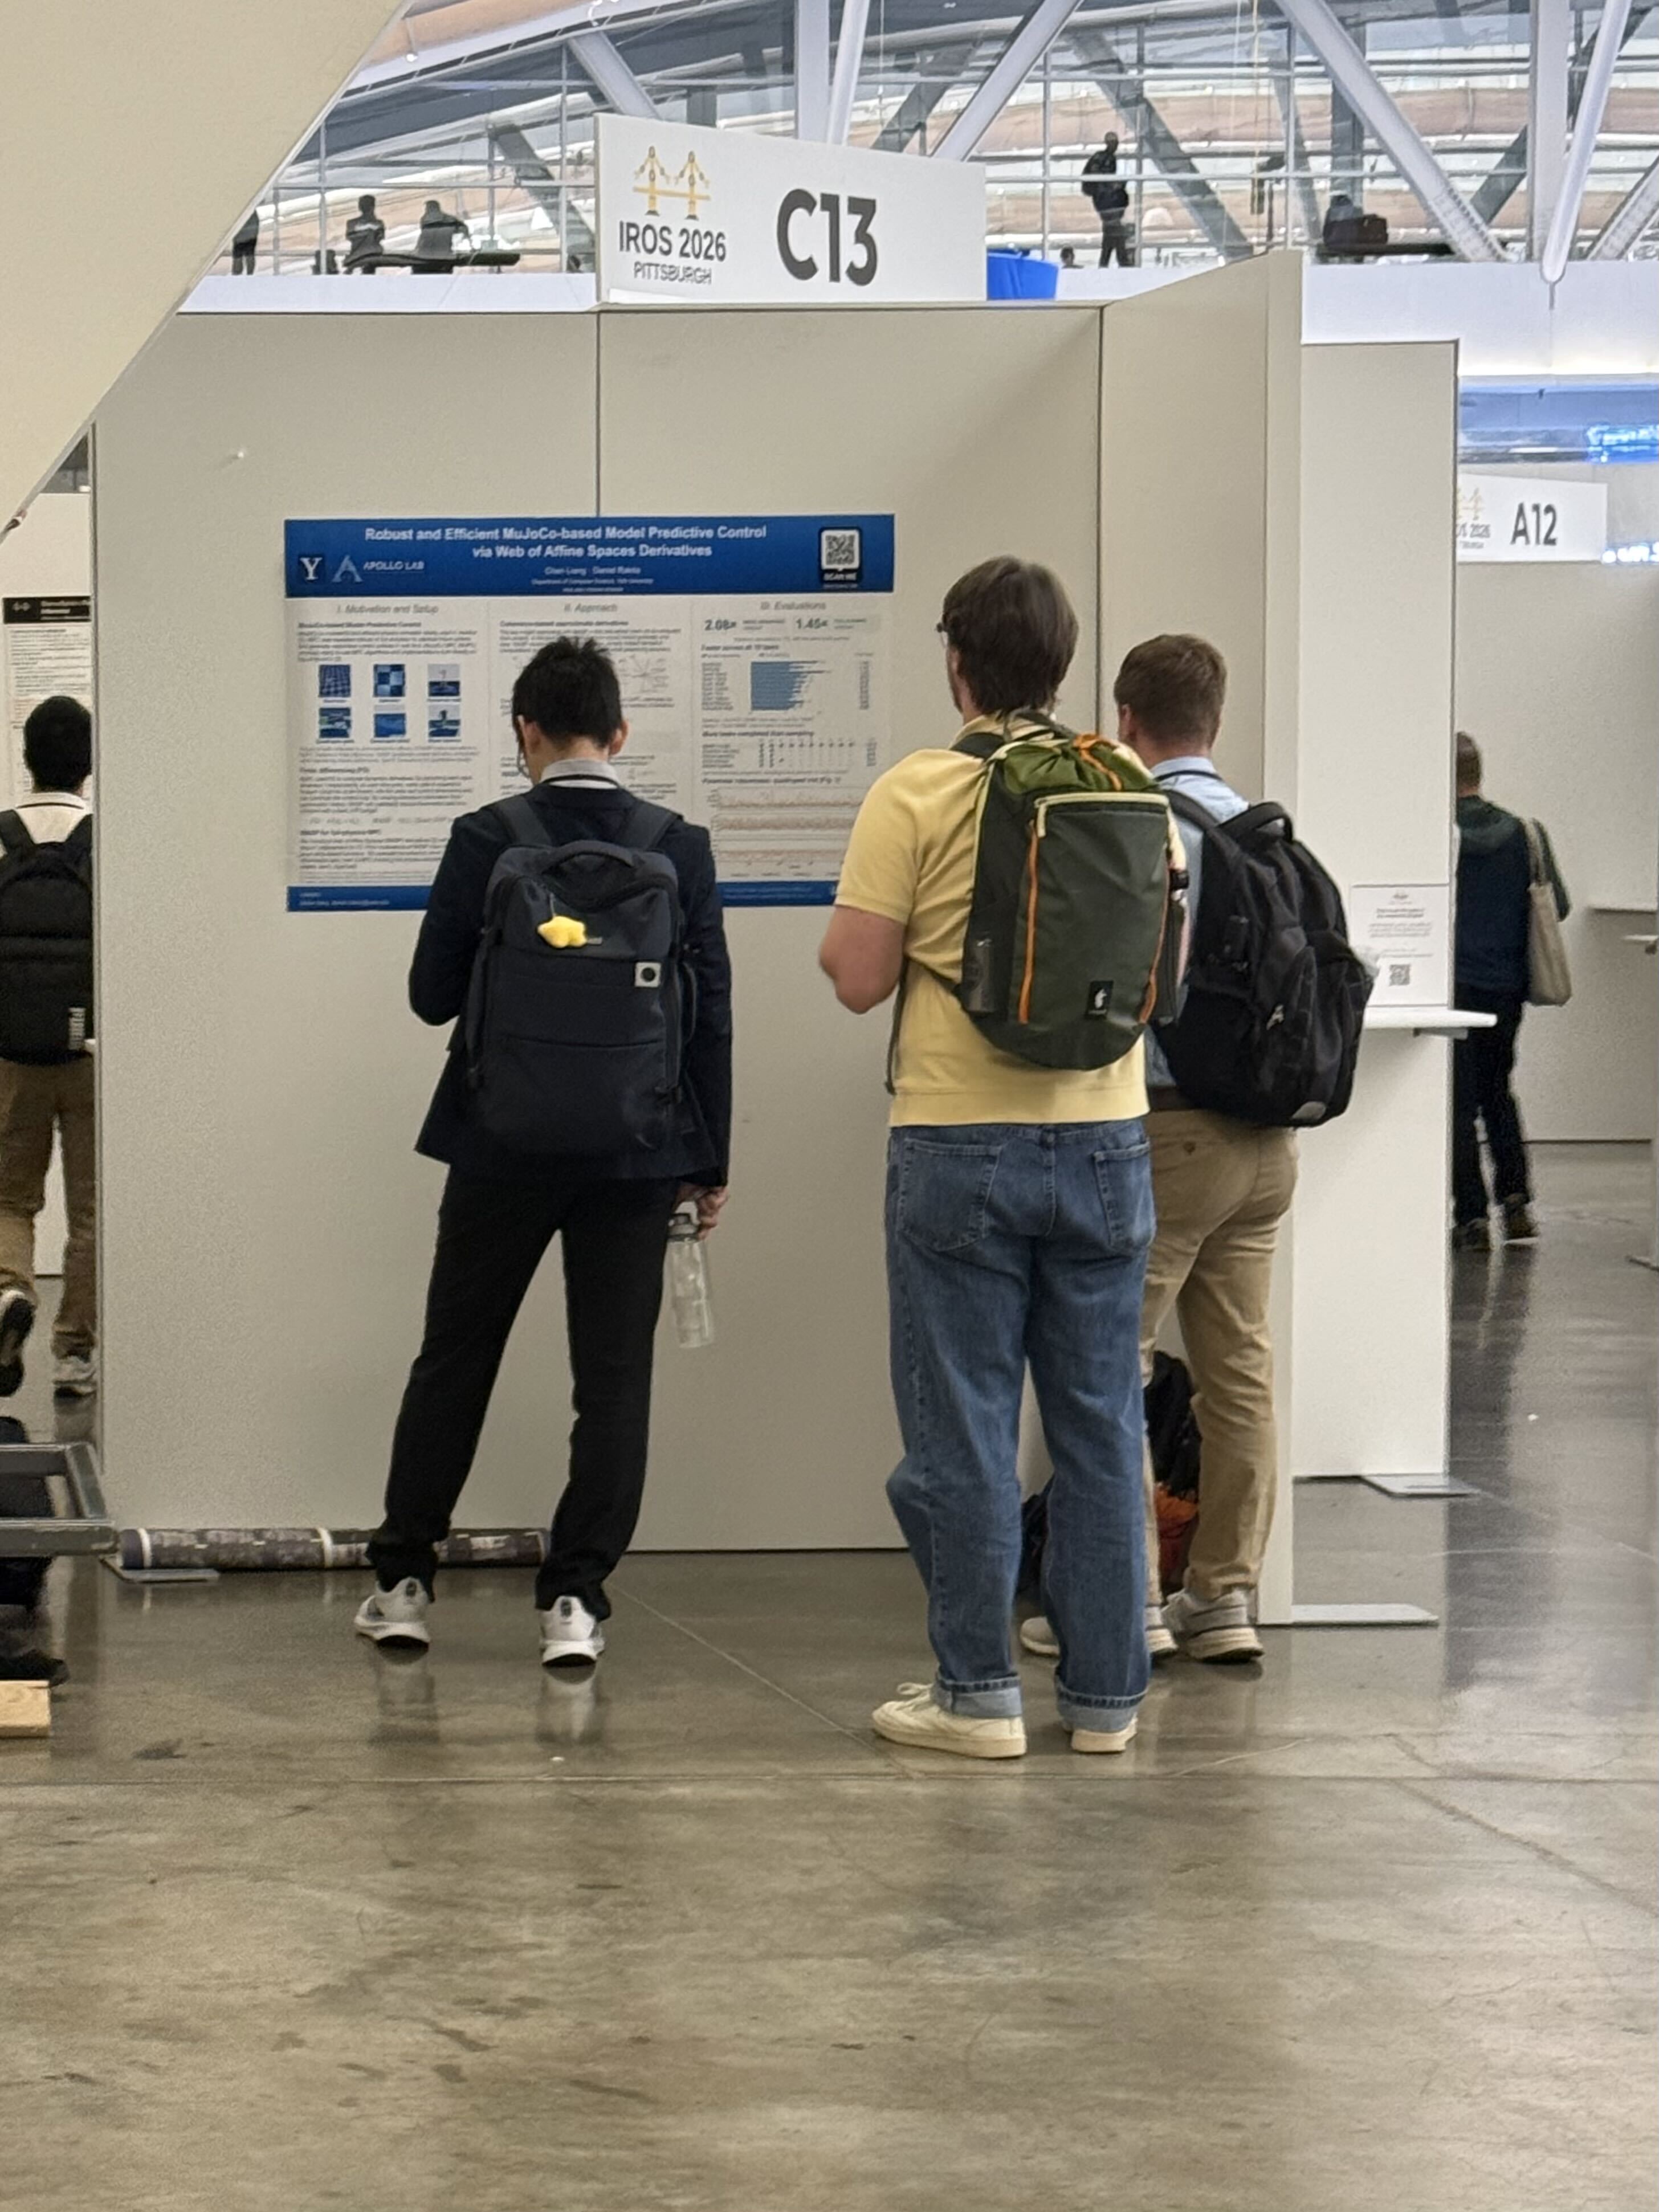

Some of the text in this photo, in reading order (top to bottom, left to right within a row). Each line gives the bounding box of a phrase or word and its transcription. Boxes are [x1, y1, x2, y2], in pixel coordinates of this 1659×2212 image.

[619, 221, 726, 262] IROS 2026
[777, 188, 878, 286] C13
[634, 261, 712, 284] PITTSBURGH
[365, 525, 767, 540] Robust and Efficient MuJoCo-based Model Predictive Control
[1510, 502, 1557, 546] A12
[472, 544, 712, 560] via Web of Affine Spaces Derivatives
[300, 557, 323, 581] Y
[363, 561, 425, 570] APOLLO LAB
